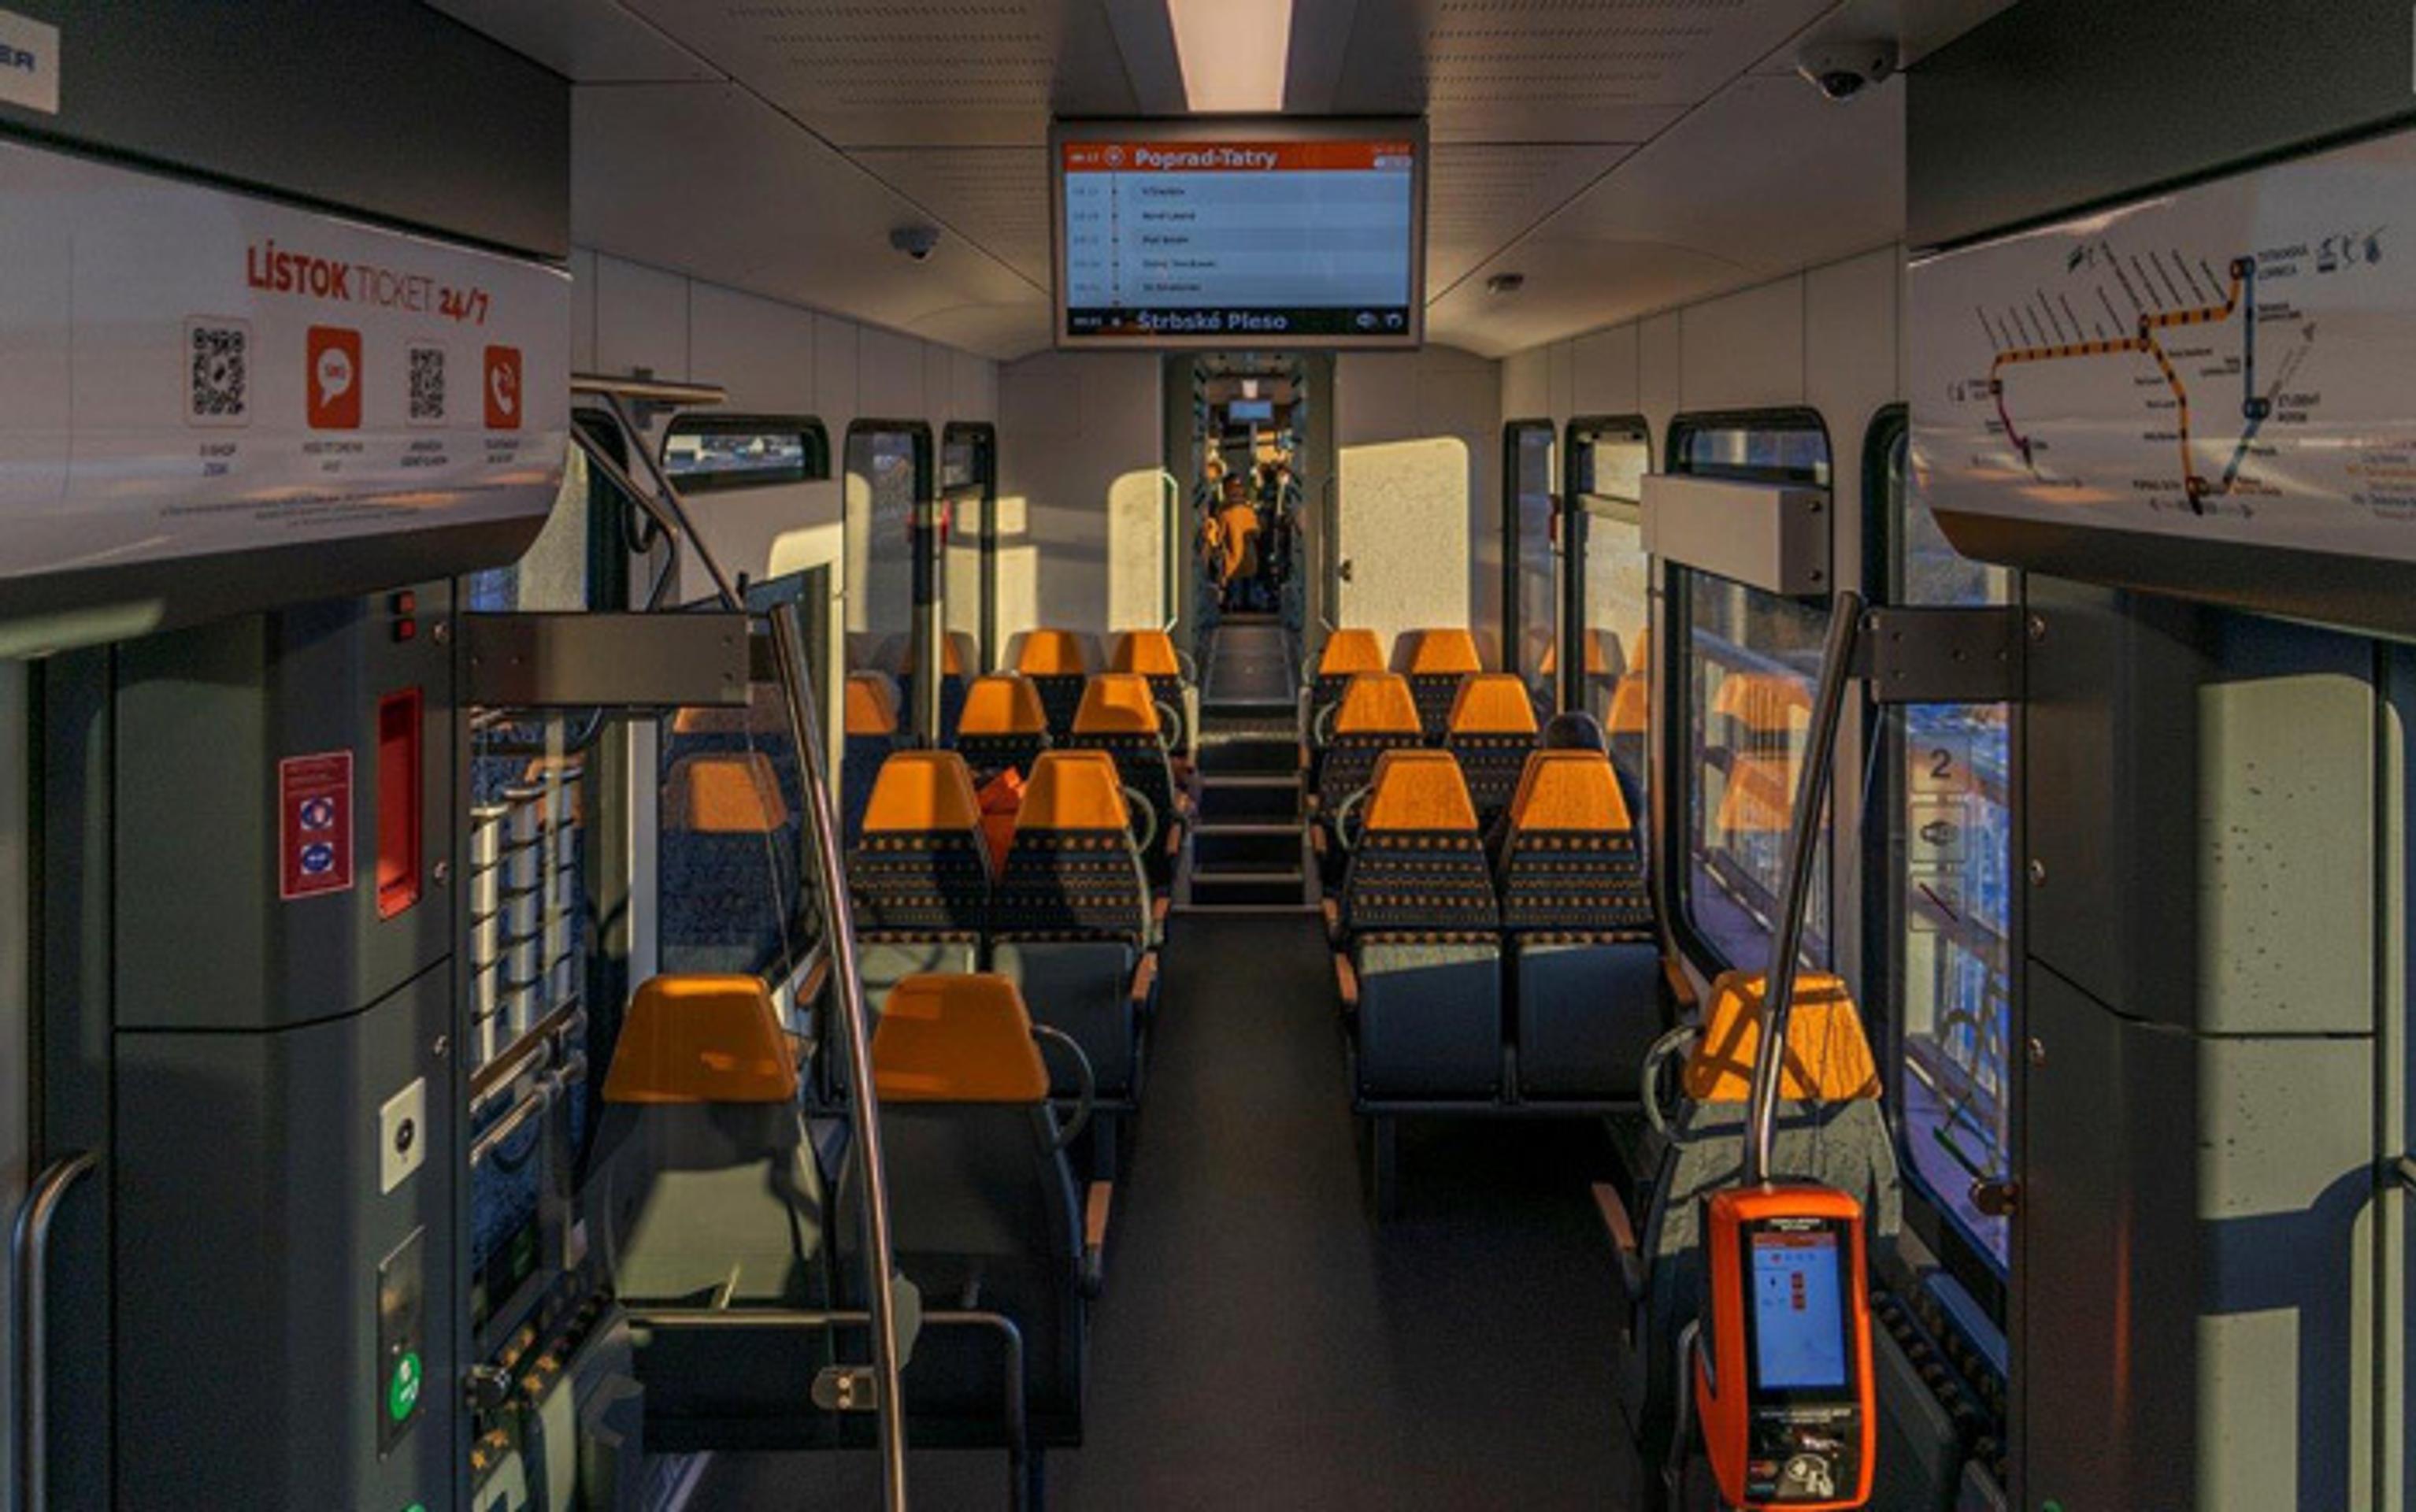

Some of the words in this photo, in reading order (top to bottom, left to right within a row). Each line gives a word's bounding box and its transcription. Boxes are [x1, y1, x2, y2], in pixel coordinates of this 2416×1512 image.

[1134, 147, 1278, 169] Poprad-Tatry
[246, 239, 350, 301] LÍSTOK
[355, 264, 435, 312] TICKET
[439, 287, 490, 325] 24/7
[1228, 312, 1288, 330] Pleso
[1929, 747, 1951, 778] 2
